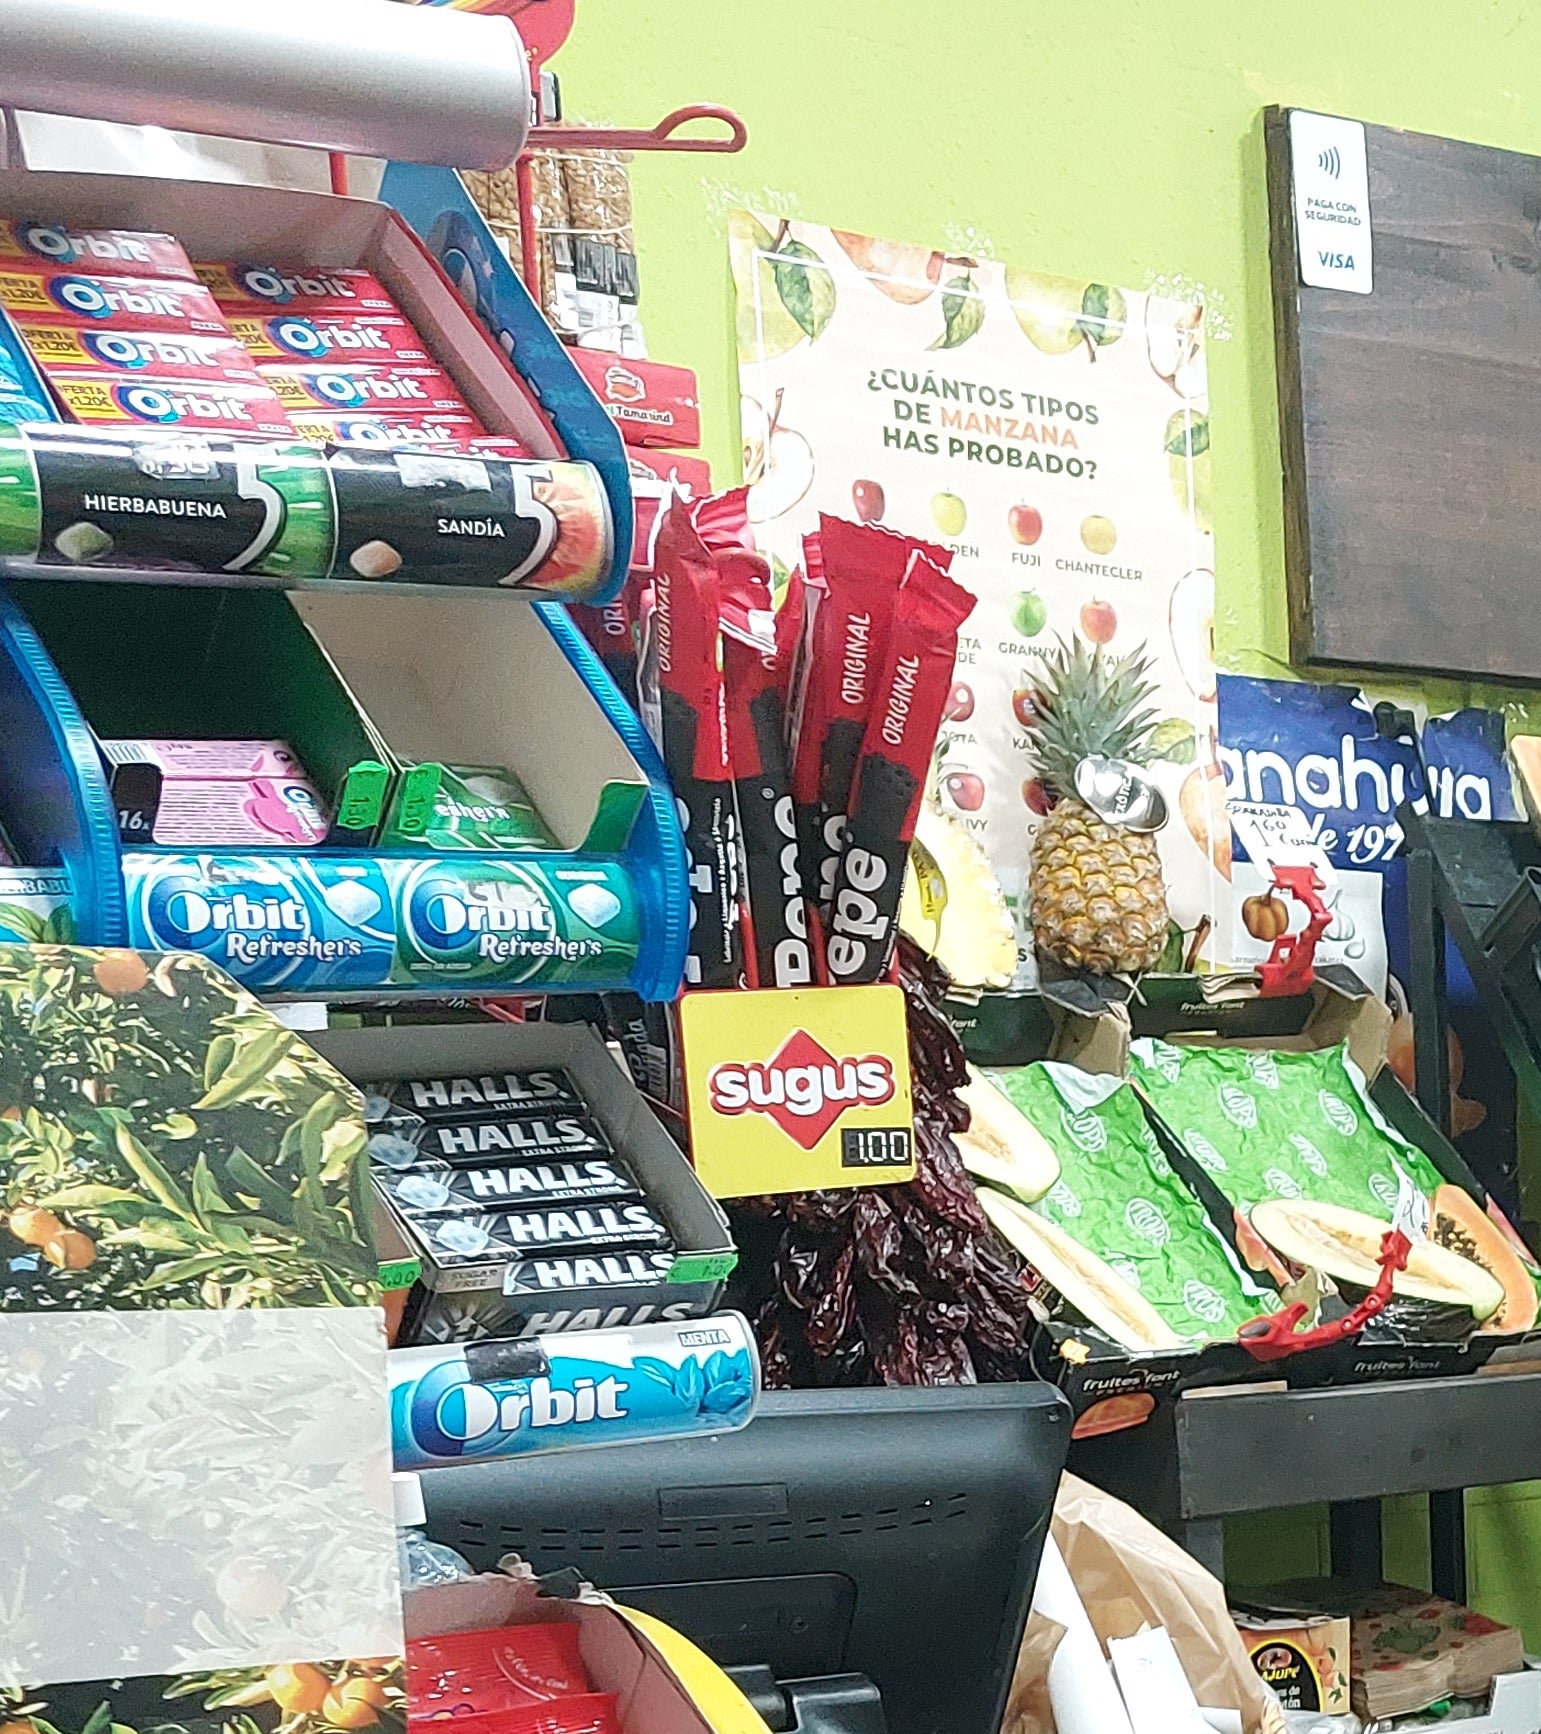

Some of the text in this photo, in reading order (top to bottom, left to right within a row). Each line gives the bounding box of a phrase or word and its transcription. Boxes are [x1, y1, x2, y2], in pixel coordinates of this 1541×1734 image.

[1305, 210, 1362, 226] SEGURIDAD
[1307, 197, 1357, 213] PAGA CON
[28, 228, 151, 262] Orbit
[1317, 251, 1355, 270] VISA
[245, 266, 357, 298] Orbit
[61, 284, 186, 317] Orbit
[279, 318, 391, 350] Orbit
[96, 334, 220, 367] Orbit
[316, 373, 428, 401] Orbit
[867, 368, 1099, 425] ¿CUÁNTOS TIPOS
[126, 388, 253, 420] Orbit
[617, 406, 672, 424] Tamarind
[893, 399, 1079, 449] DE MANZANA
[883, 426, 1098, 480] HAS PROBADO?
[83, 493, 227, 520] HIERBABUENA
[437, 517, 506, 538] SANDÍA
[1011, 552, 1041, 567] FUJI
[1055, 559, 1143, 581] CHANTECLER
[656, 572, 673, 673] ORIGINAL
[841, 612, 871, 704] ORIGINAL
[882, 655, 920, 745] ORIGINAL
[435, 803, 510, 821] eshers
[168, 891, 306, 935] Orbit
[427, 894, 553, 935] Orbit
[226, 931, 362, 963] Refreshers
[478, 932, 602, 963] Refreshers
[410, 1071, 558, 1108] HALLS
[714, 1062, 889, 1117] sugus
[438, 1117, 587, 1155] HALLS
[857, 1131, 910, 1164] 1.00
[465, 1161, 619, 1196] HALLS
[586, 1185, 623, 1197] STRONG
[506, 1205, 657, 1243] HALLS
[451, 1267, 500, 1283] SUGAR
[533, 1251, 676, 1288] HALLS
[679, 1328, 732, 1347] MENTA
[1083, 1369, 1181, 1392] fruites font
[437, 1375, 631, 1442] Orbit
